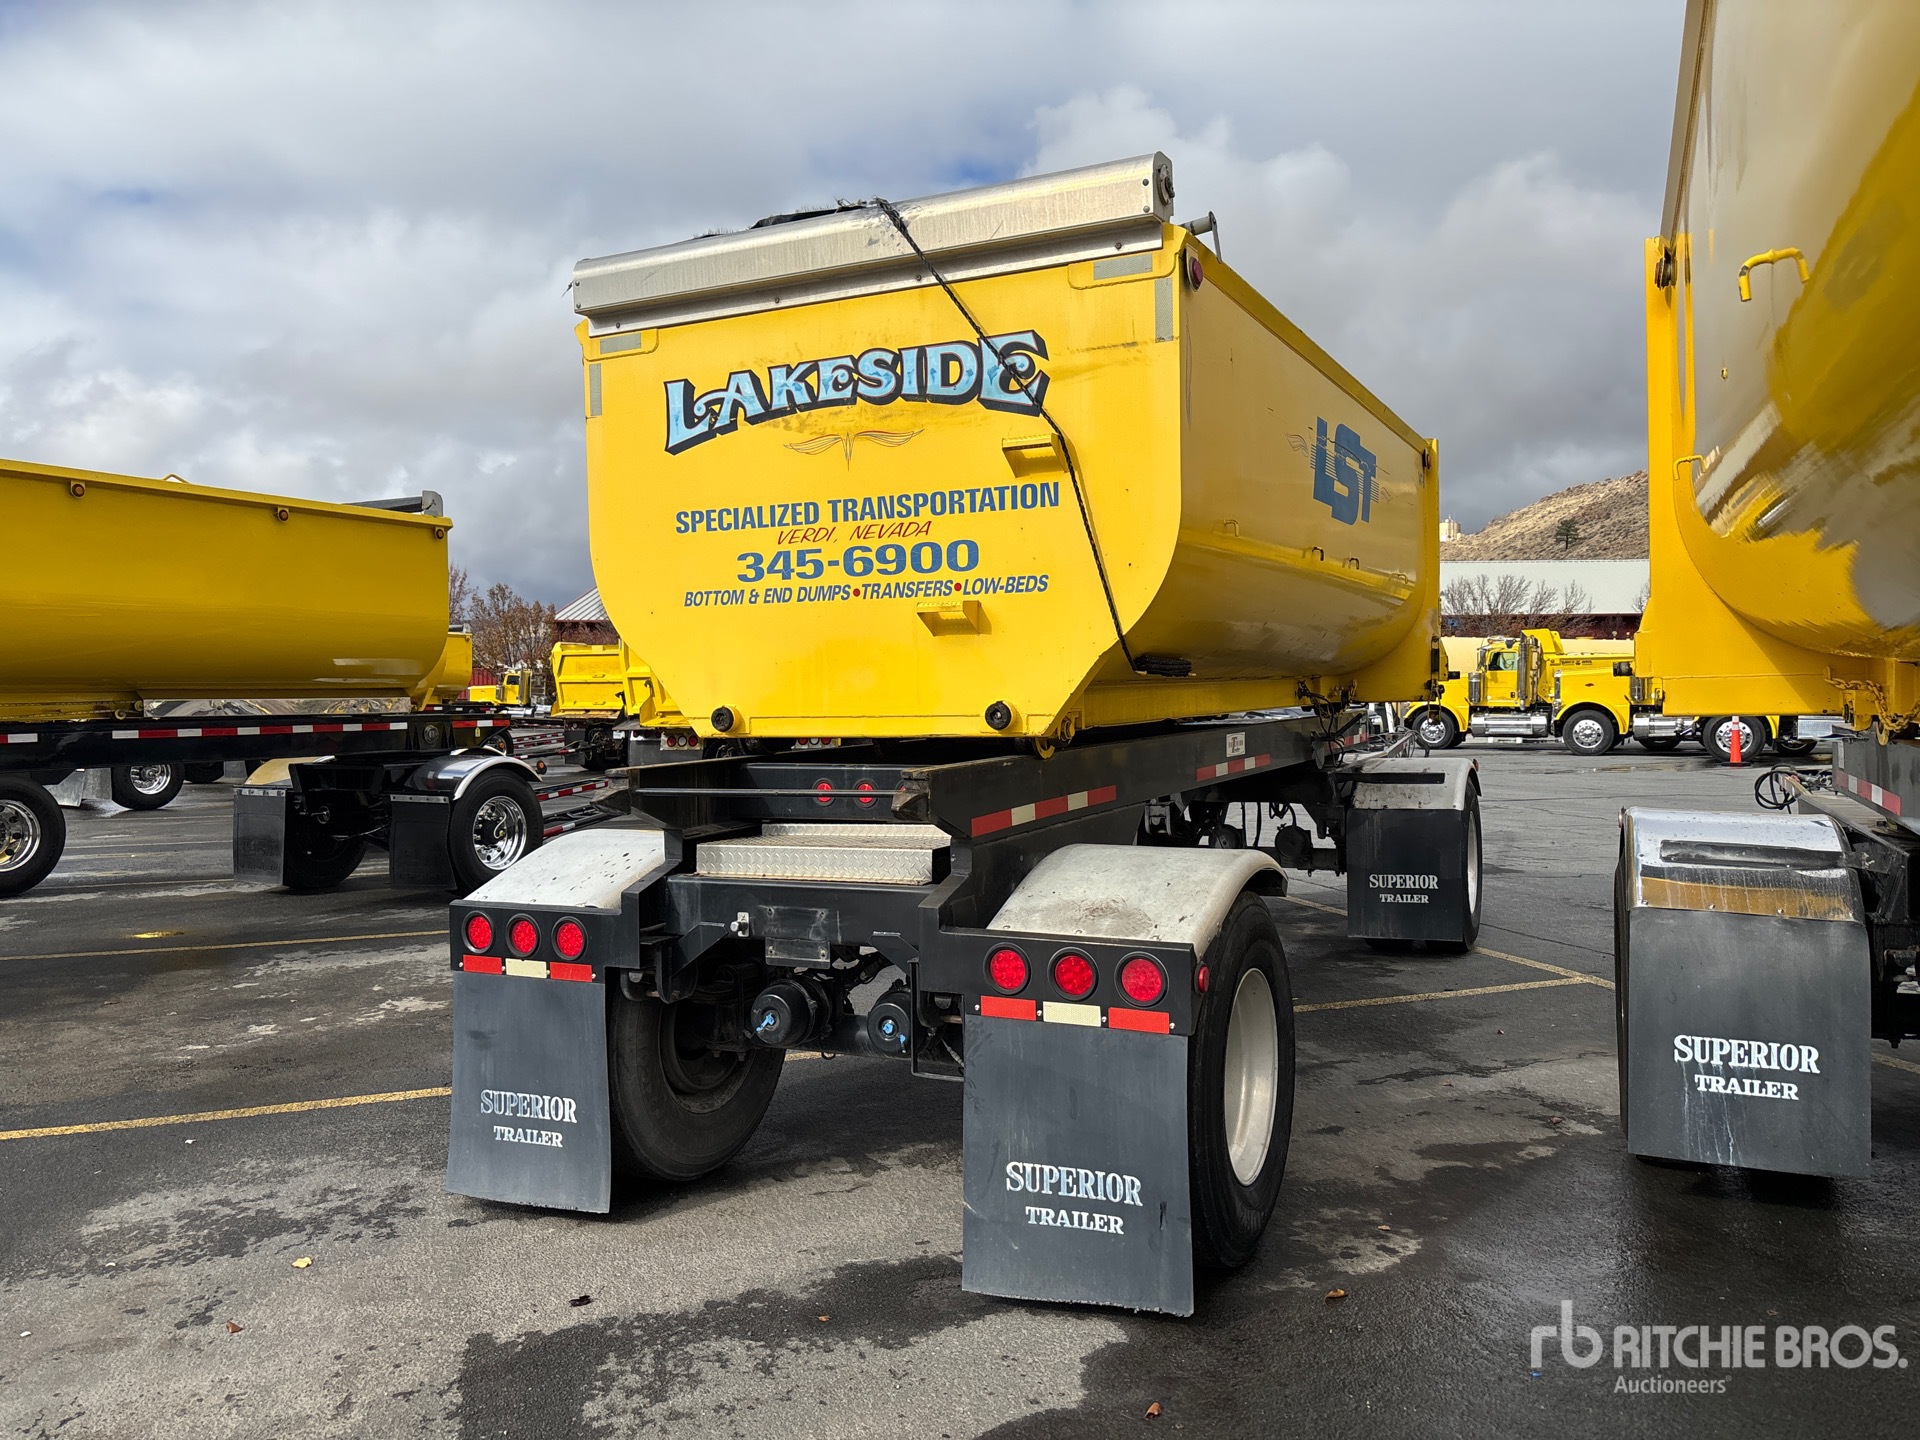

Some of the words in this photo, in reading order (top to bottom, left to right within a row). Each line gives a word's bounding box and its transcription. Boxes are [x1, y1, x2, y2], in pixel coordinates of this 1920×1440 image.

[663, 330, 1050, 456] LAKESIDE
[675, 502, 820, 534] SPECIALIZED
[827, 482, 1060, 523] TRANSPORTATION
[777, 526, 839, 545] VERDI,
[849, 521, 932, 541] NEVADA
[736, 539, 980, 583] 345-6900
[684, 589, 747, 607] BOTTOM
[749, 590, 760, 604] &
[763, 587, 793, 604] END
[796, 584, 851, 603] DUMPS
[860, 580, 954, 600] TRANSFERS
[962, 574, 1049, 596] LOW-BEDS
[1368, 873, 1439, 889] SUPERIOR
[1379, 893, 1429, 904] TRAILER
[1673, 1034, 1821, 1074] SUPERIOR
[1694, 1074, 1800, 1101] TRAILER
[480, 1089, 578, 1123] SUPERIOR
[493, 1125, 563, 1148] TRAILER
[1006, 1161, 1144, 1207] SUPERIOR
[1025, 1206, 1125, 1235] TRAILER
